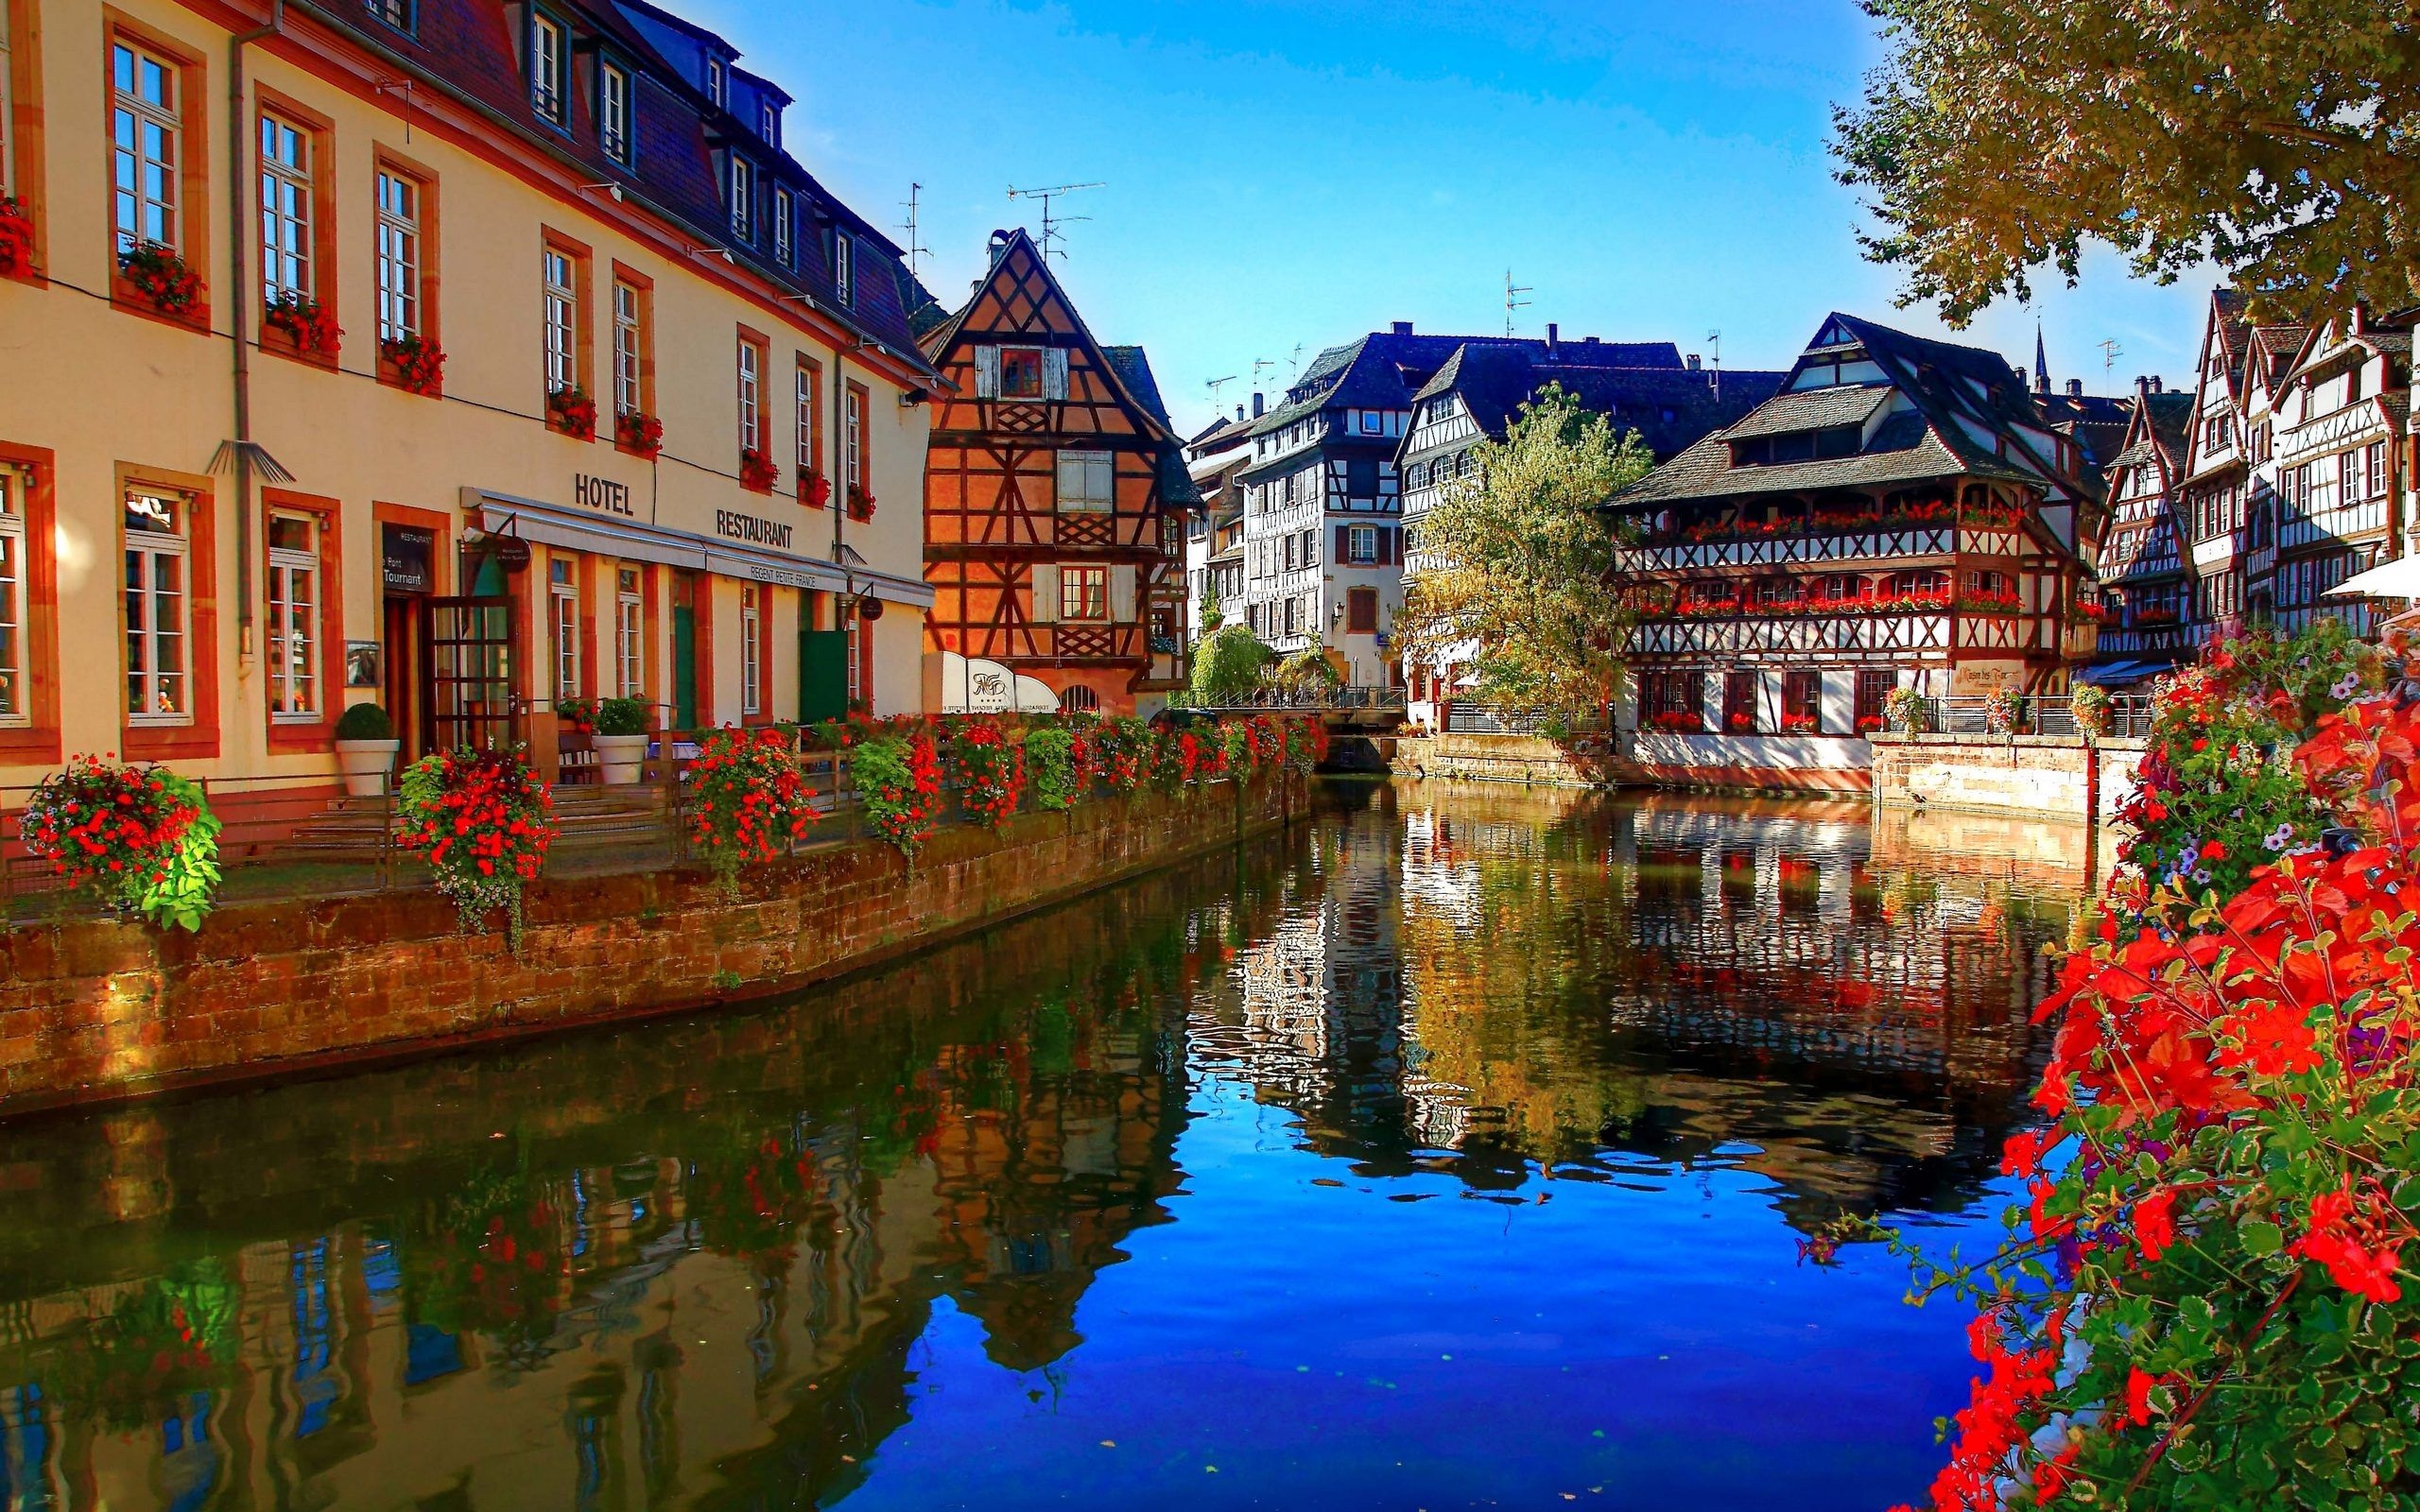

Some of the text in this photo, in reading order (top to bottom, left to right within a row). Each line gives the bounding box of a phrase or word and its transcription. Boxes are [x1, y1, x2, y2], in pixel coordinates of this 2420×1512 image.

[576, 472, 633, 517] HOTEL
[717, 508, 792, 549] RESTAURANT
[384, 569, 422, 586] Tournant
[751, 566, 816, 588] REGENT PETITE FRANCE
